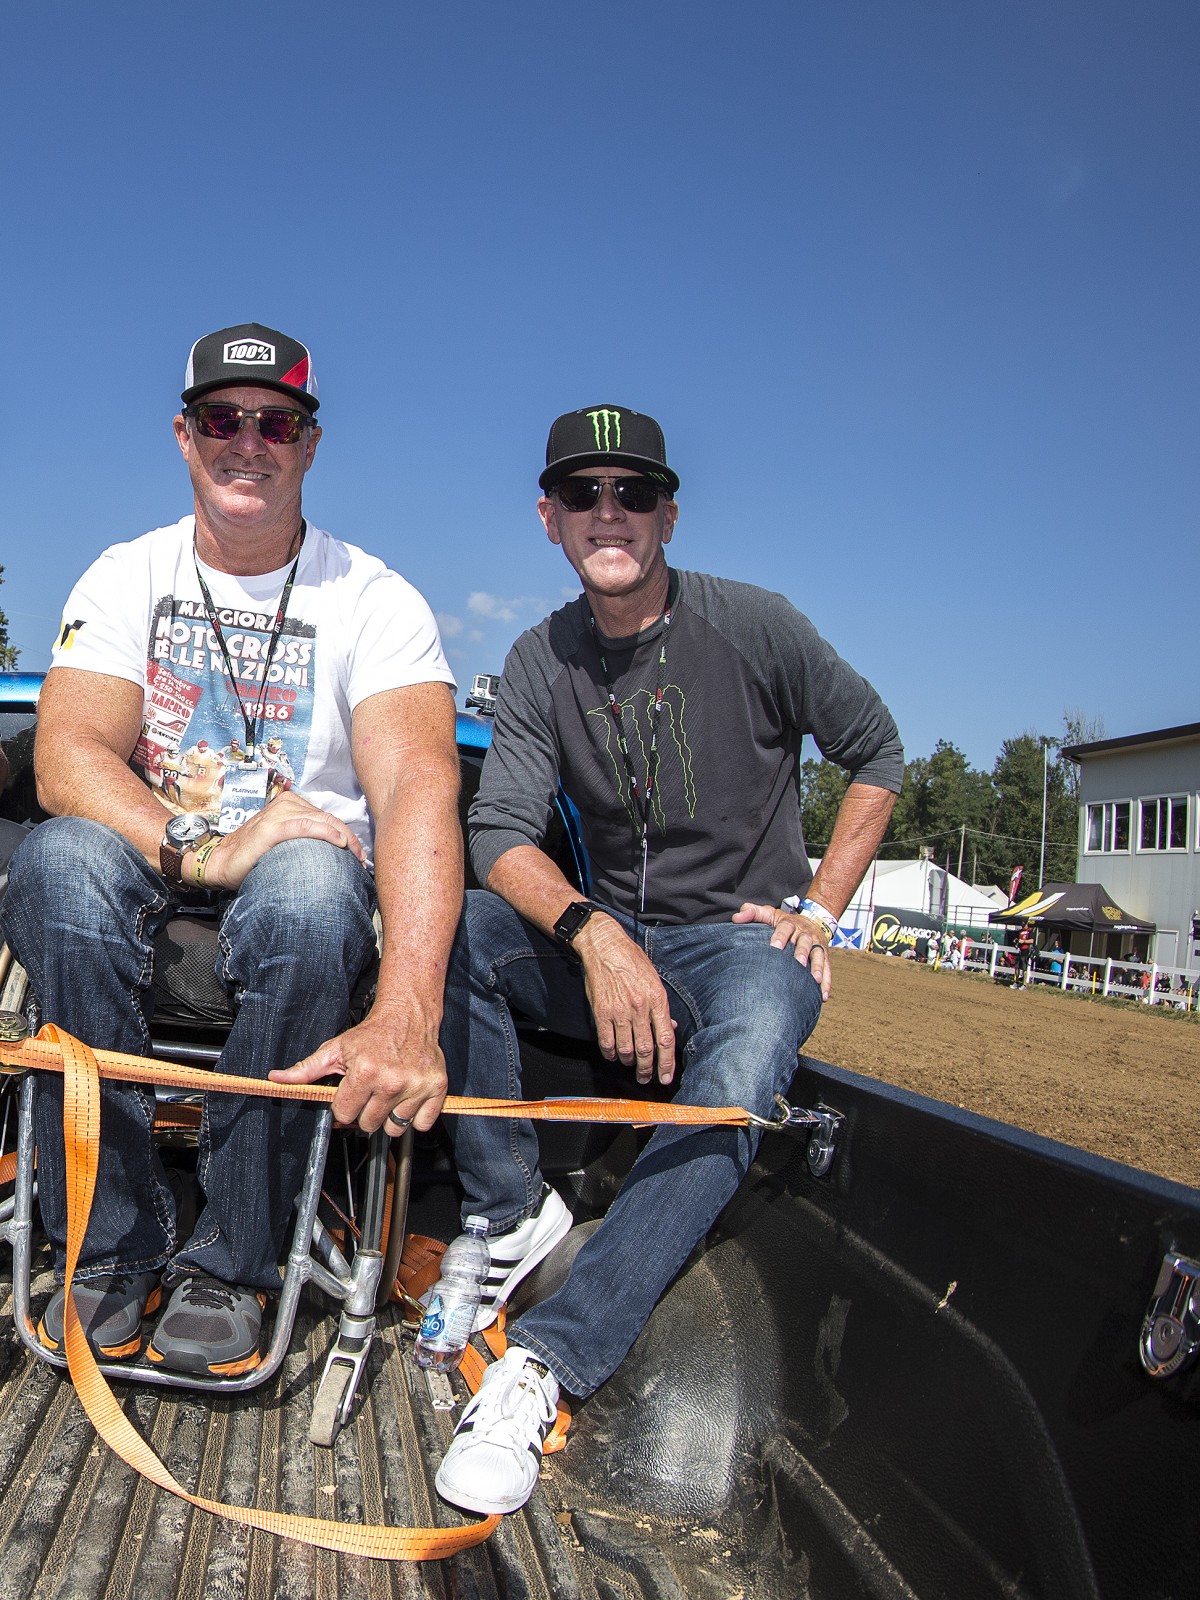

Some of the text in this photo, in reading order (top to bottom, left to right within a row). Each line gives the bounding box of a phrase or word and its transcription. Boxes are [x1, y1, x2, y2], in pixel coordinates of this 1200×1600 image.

[230, 344, 269, 361] 100%
[155, 615, 313, 667] MOTOCROSS
[210, 650, 309, 688] NAZIONI
[244, 701, 289, 720] 1986
[231, 787, 259, 795] PLATINUM
[896, 934, 918, 947] PARK
